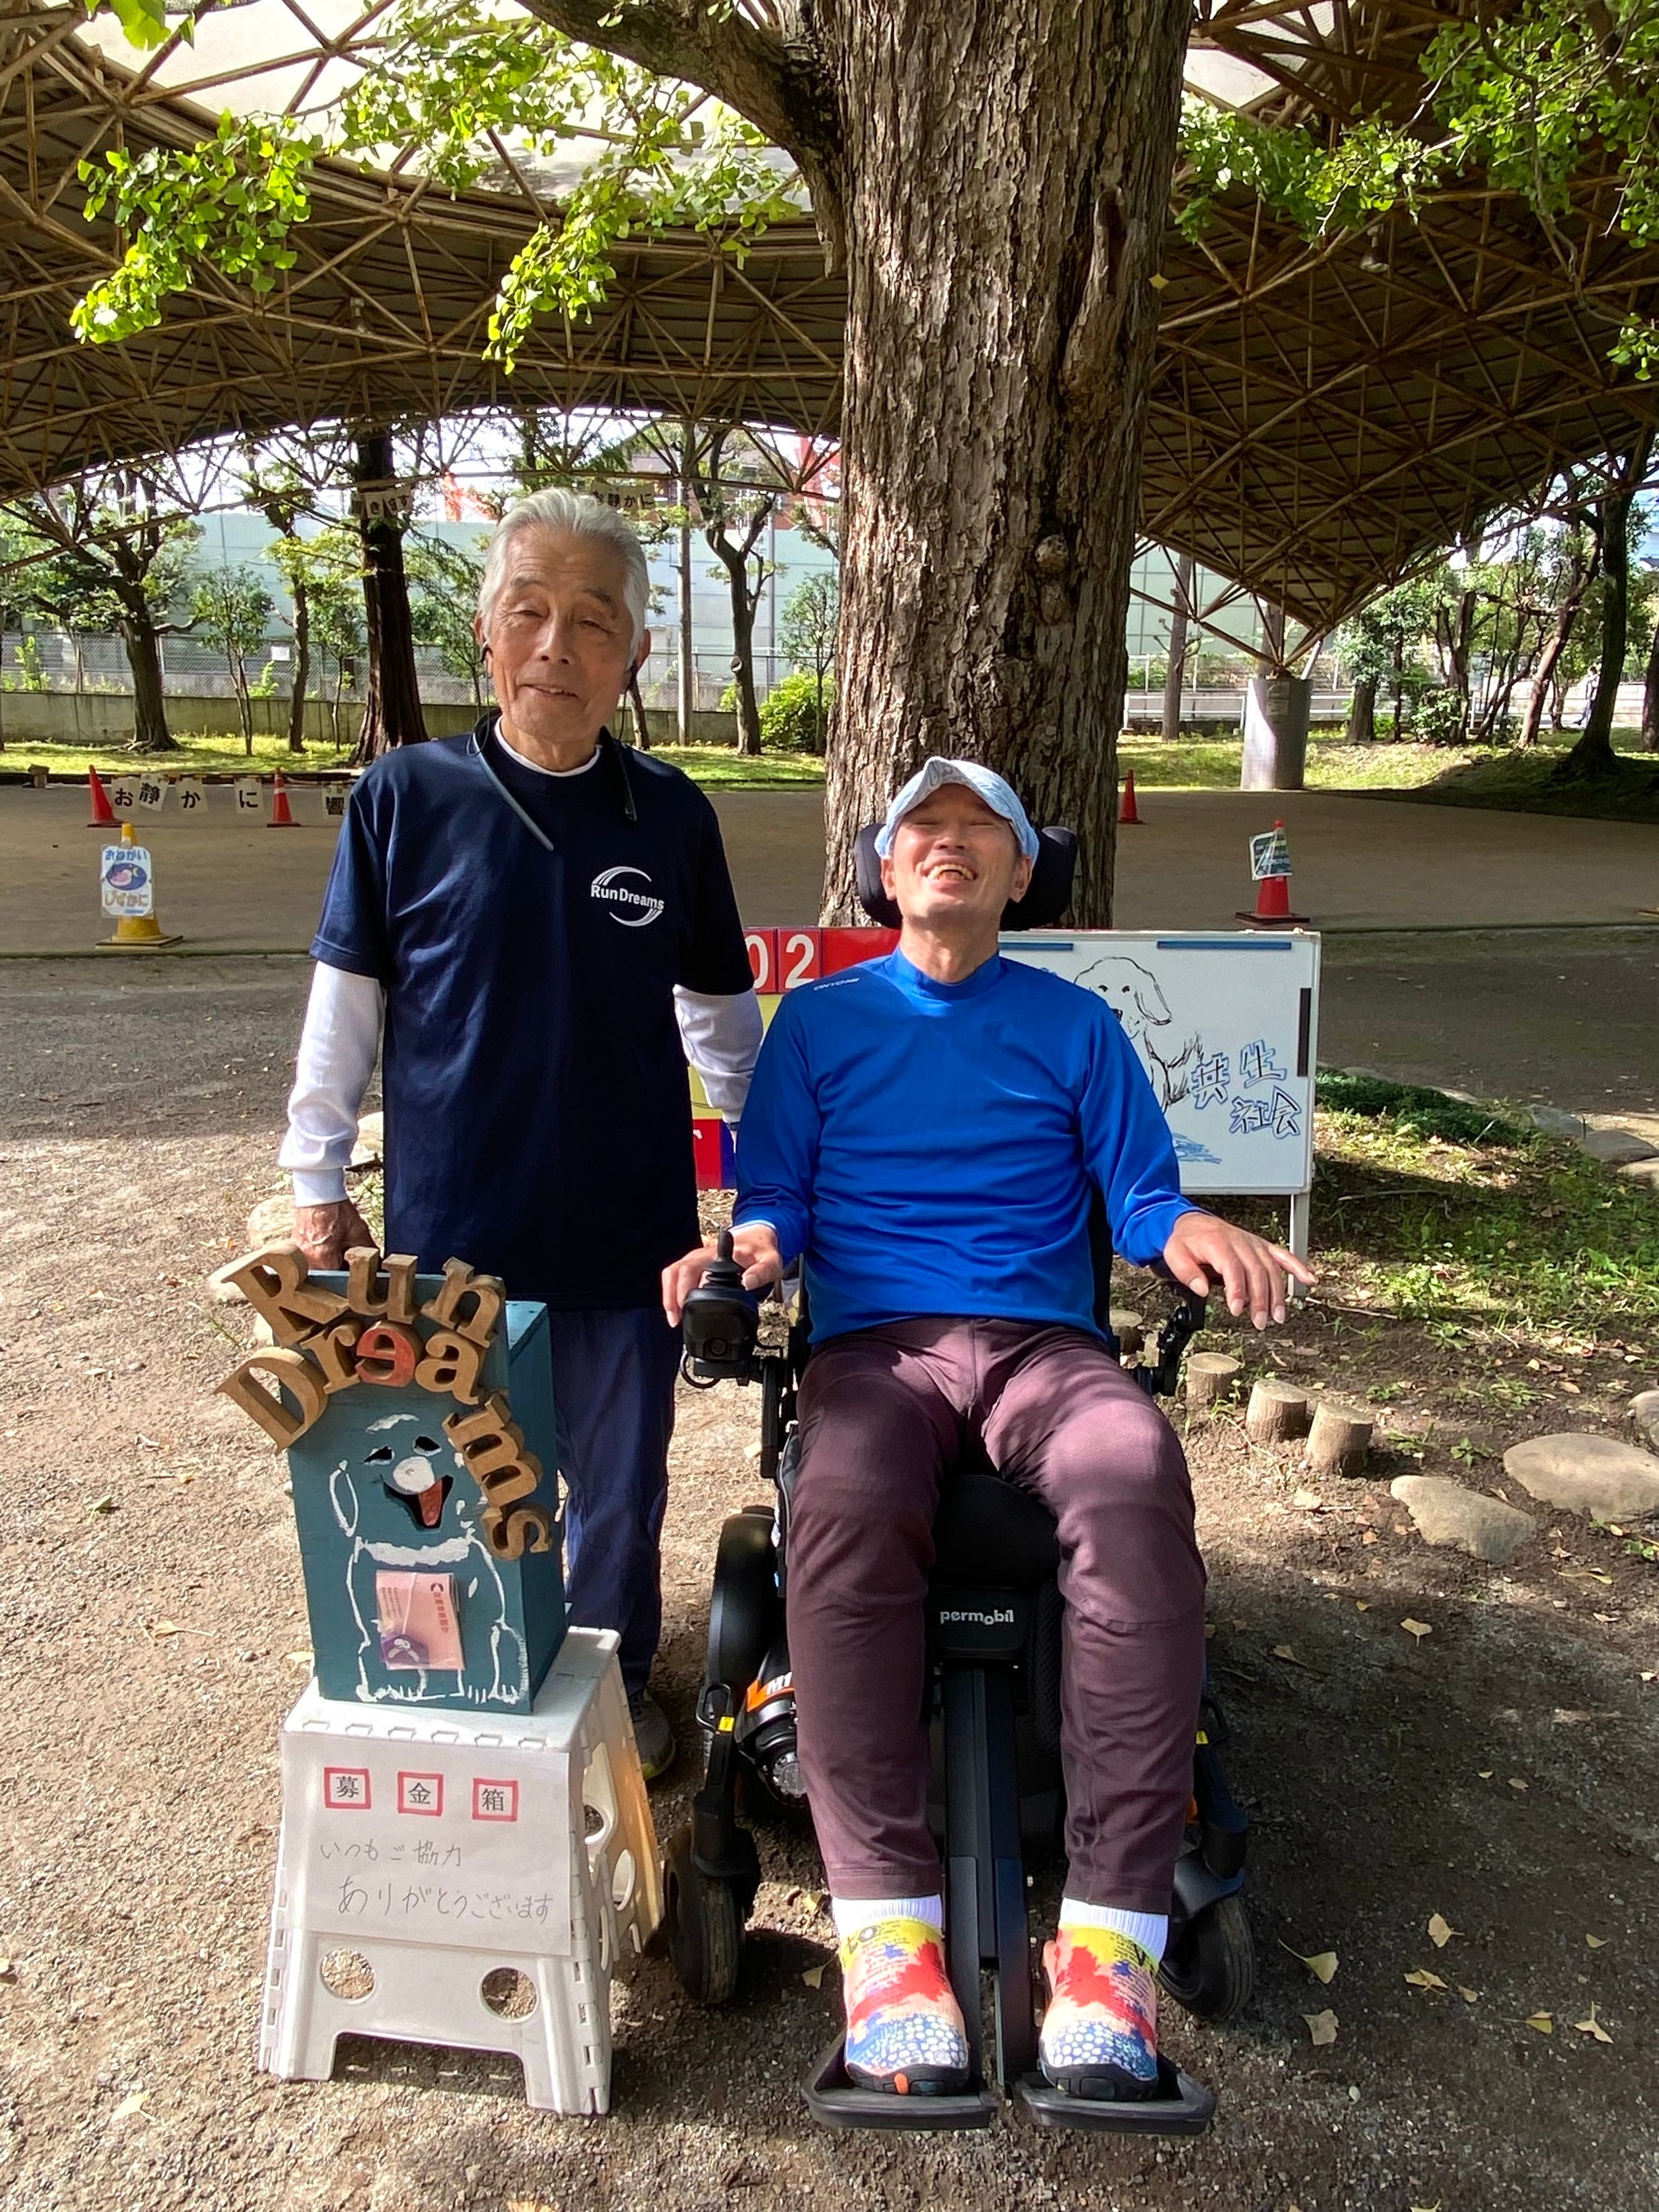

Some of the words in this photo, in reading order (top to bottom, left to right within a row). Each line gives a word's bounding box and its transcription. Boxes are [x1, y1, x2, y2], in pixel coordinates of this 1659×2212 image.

[115, 782, 258, 809] お静かに
[1229, 1086, 1302, 1140] 社会
[211, 1239, 505, 1349] Run
[213, 1320, 554, 1562] Dreams
[940, 1609, 1014, 1625] permobil
[334, 1775, 505, 1813] 募金箱
[337, 1875, 555, 1925] ありがとうございます
